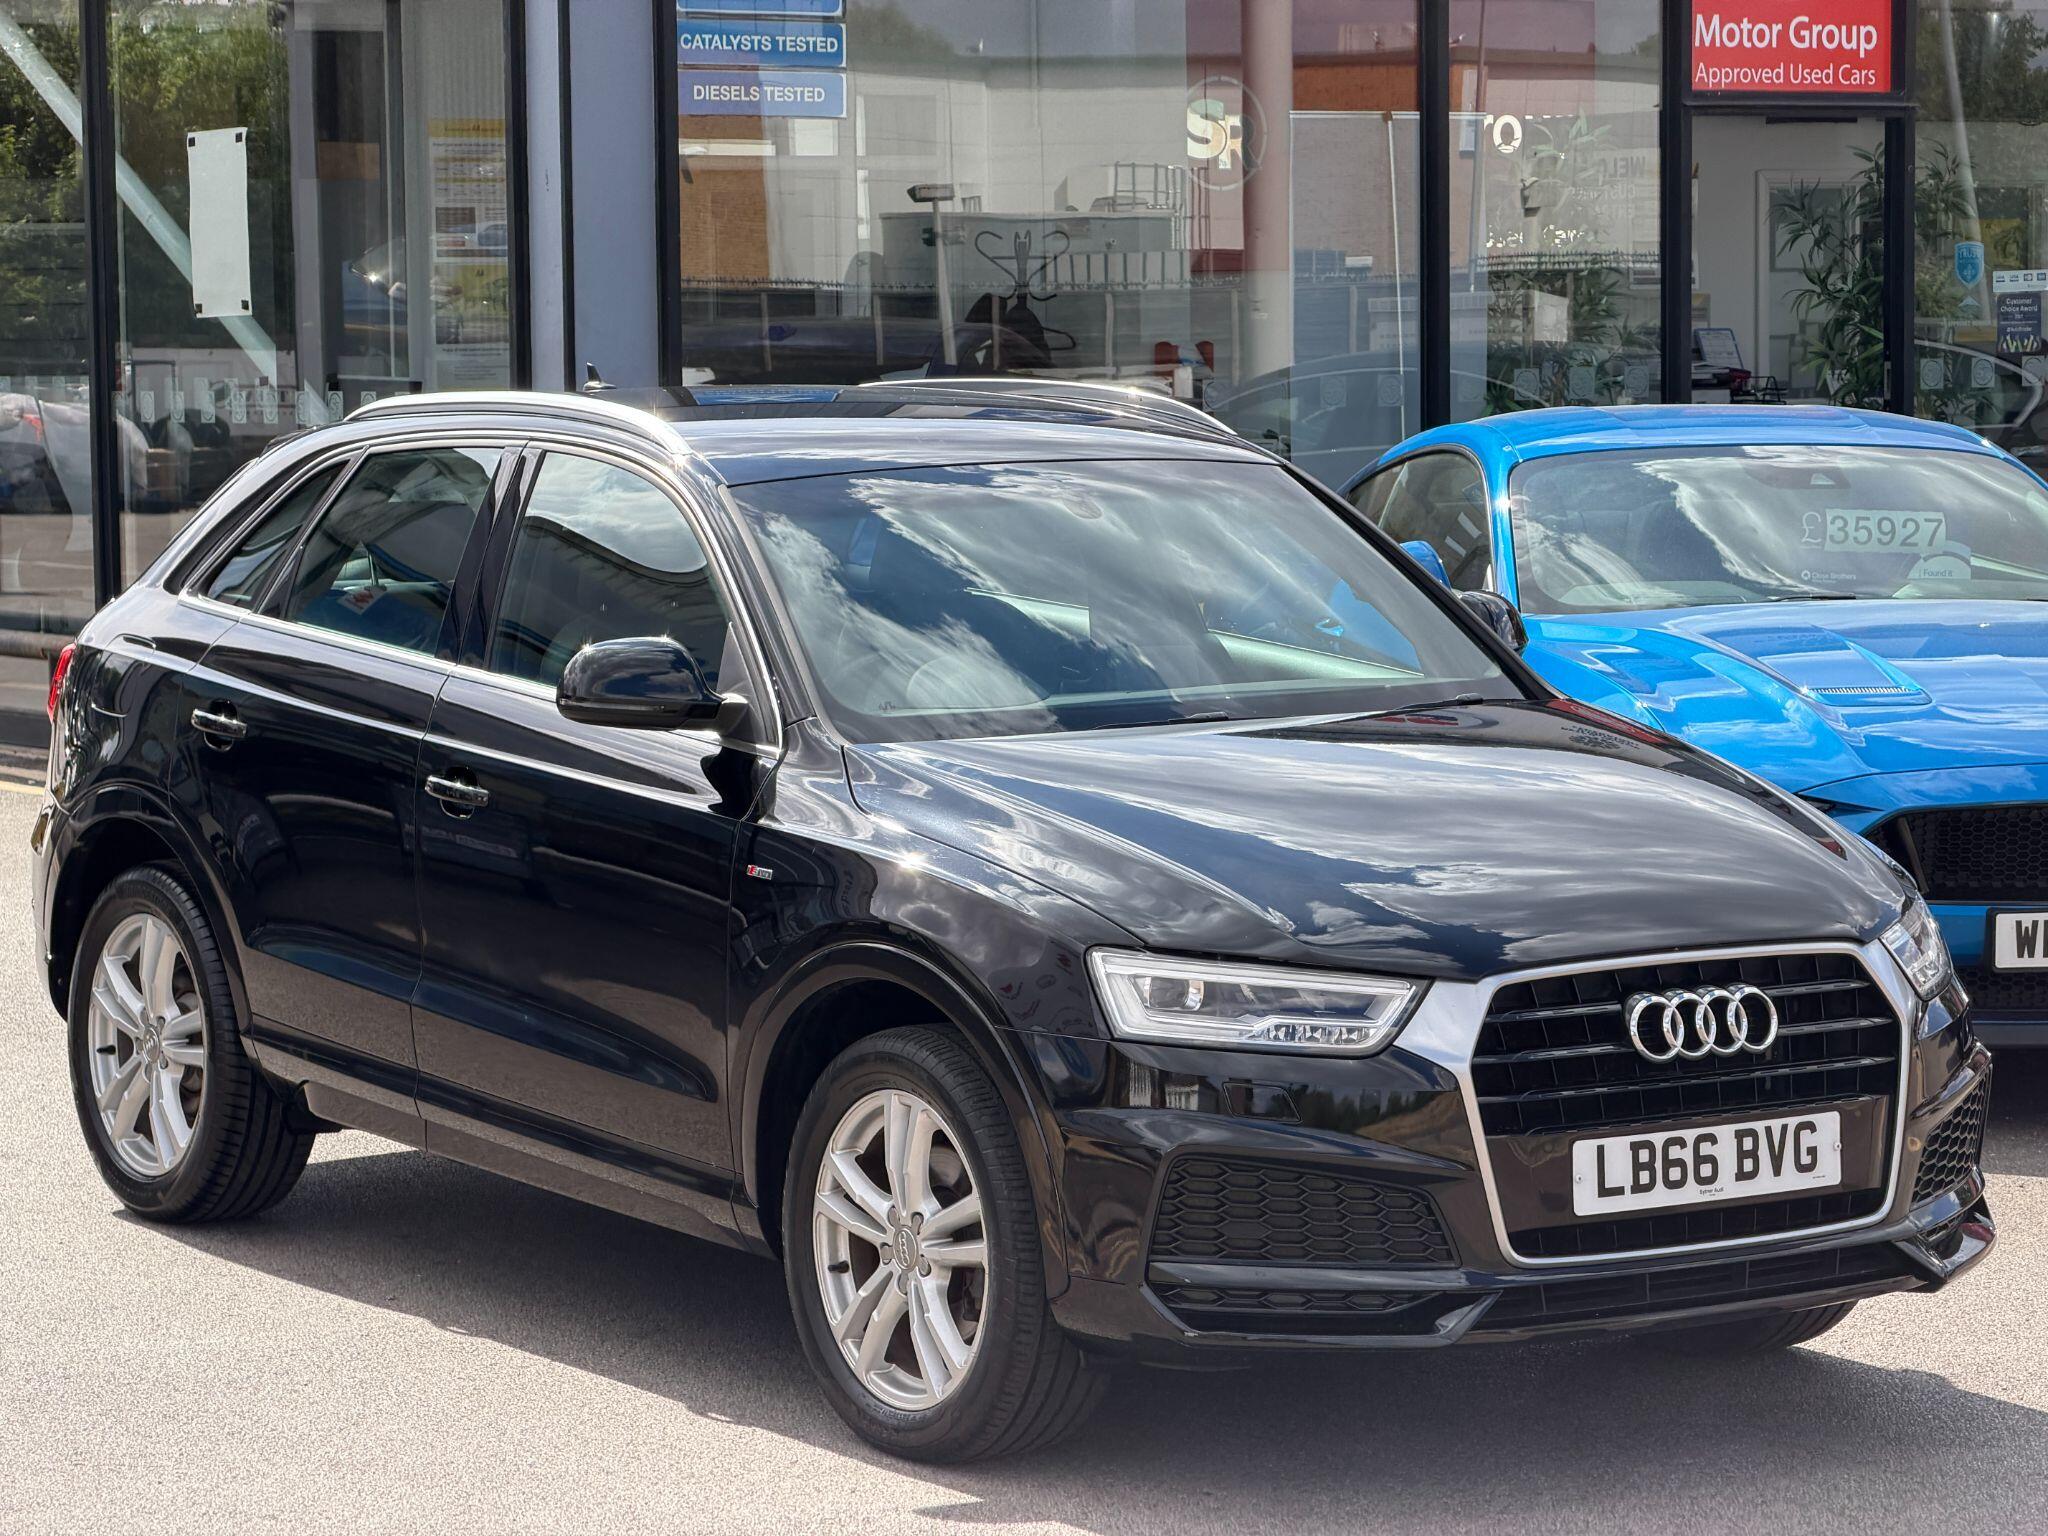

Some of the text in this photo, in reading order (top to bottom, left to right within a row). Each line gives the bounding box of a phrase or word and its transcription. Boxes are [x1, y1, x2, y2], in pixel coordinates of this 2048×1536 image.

[680, 33, 839, 53] CATALYSTS TESTED
[1694, 14, 1878, 58] Motor Group
[1695, 62, 1876, 88] Approved Used Cars
[693, 85, 826, 102] DIESELS TESTED
[1923, 569, 1947, 577] Found
[1596, 1120, 1818, 1198] LB66 BVG
